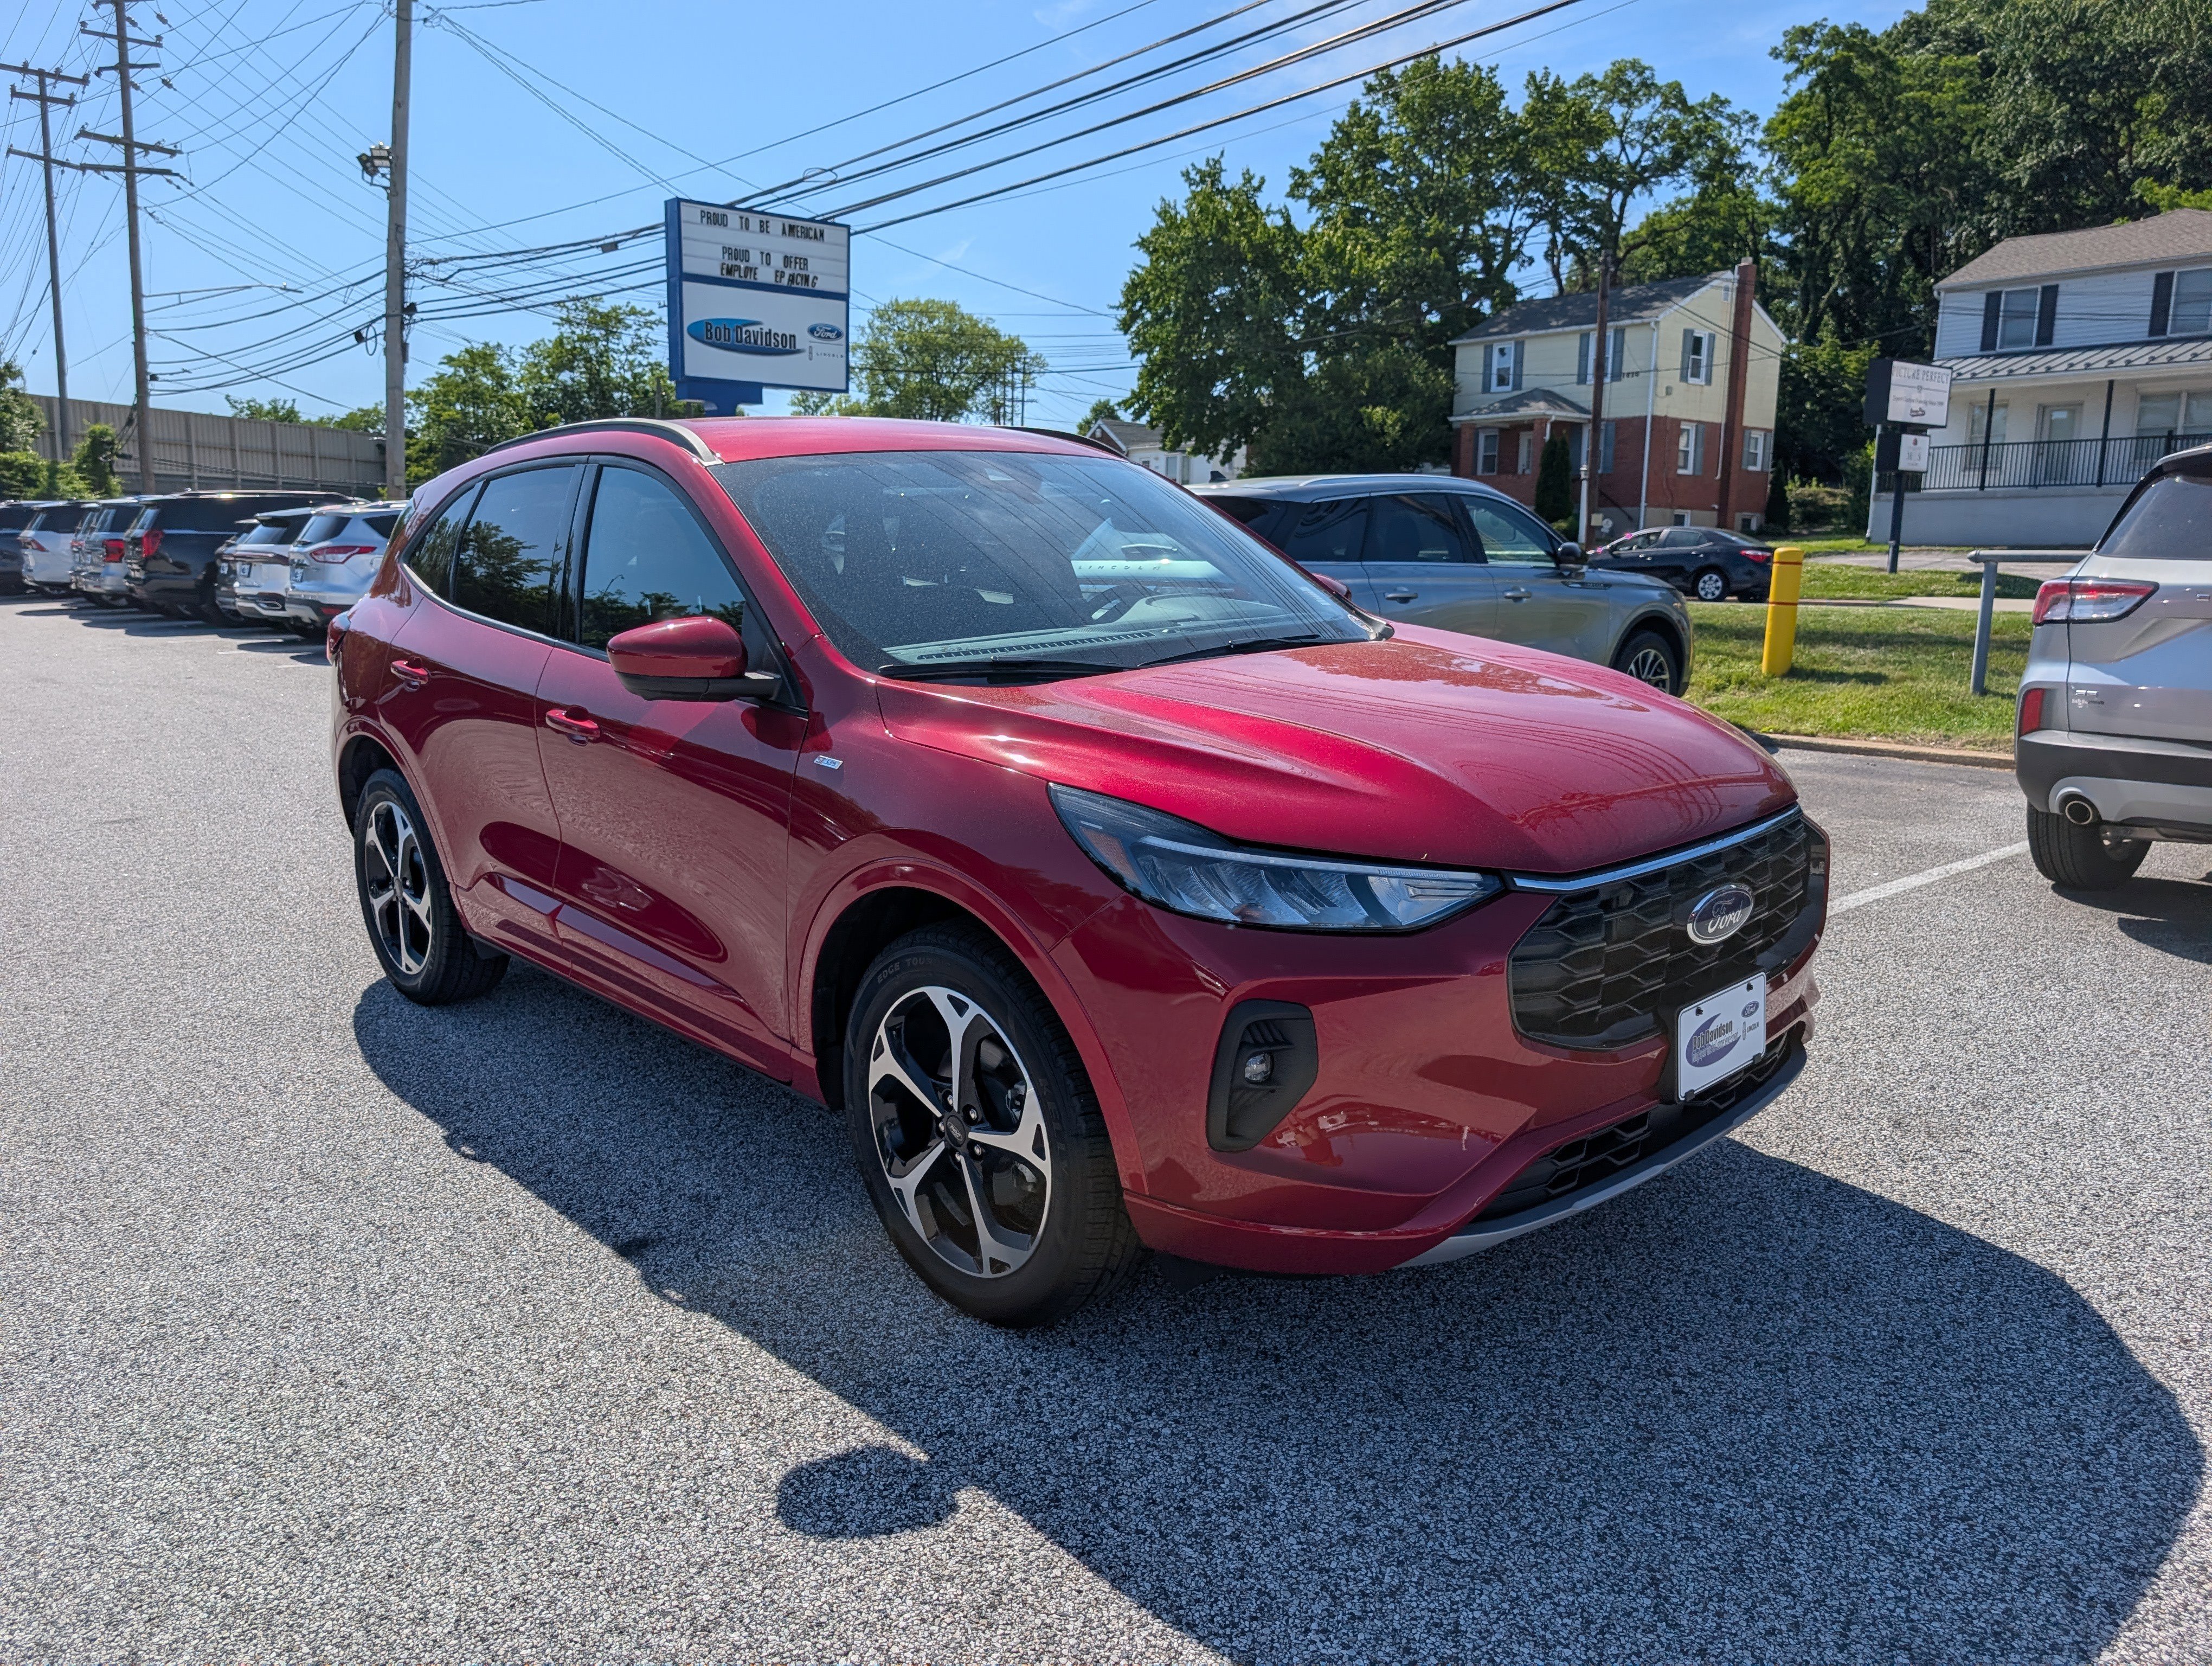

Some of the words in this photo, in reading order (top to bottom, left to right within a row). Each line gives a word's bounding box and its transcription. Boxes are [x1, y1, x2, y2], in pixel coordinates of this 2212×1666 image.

[700, 209, 729, 227] PROUD
[739, 216, 750, 230] TO
[759, 220, 770, 234] BE
[782, 223, 825, 242] AMERICAN
[722, 246, 750, 262] PROUD
[760, 251, 771, 266] TO
[783, 255, 808, 271] OFFER
[705, 322, 731, 343] Bob
[735, 325, 796, 349] Davidson
[813, 325, 838, 339] Ford
[1922, 370, 1949, 384] PERFECT
[1708, 897, 1744, 933] Ford
[877, 962, 901, 983] EDGE
[1744, 1003, 1757, 1016] Ford
[1693, 1032, 1705, 1050] Bob
[1706, 1020, 1733, 1042] Davidson
